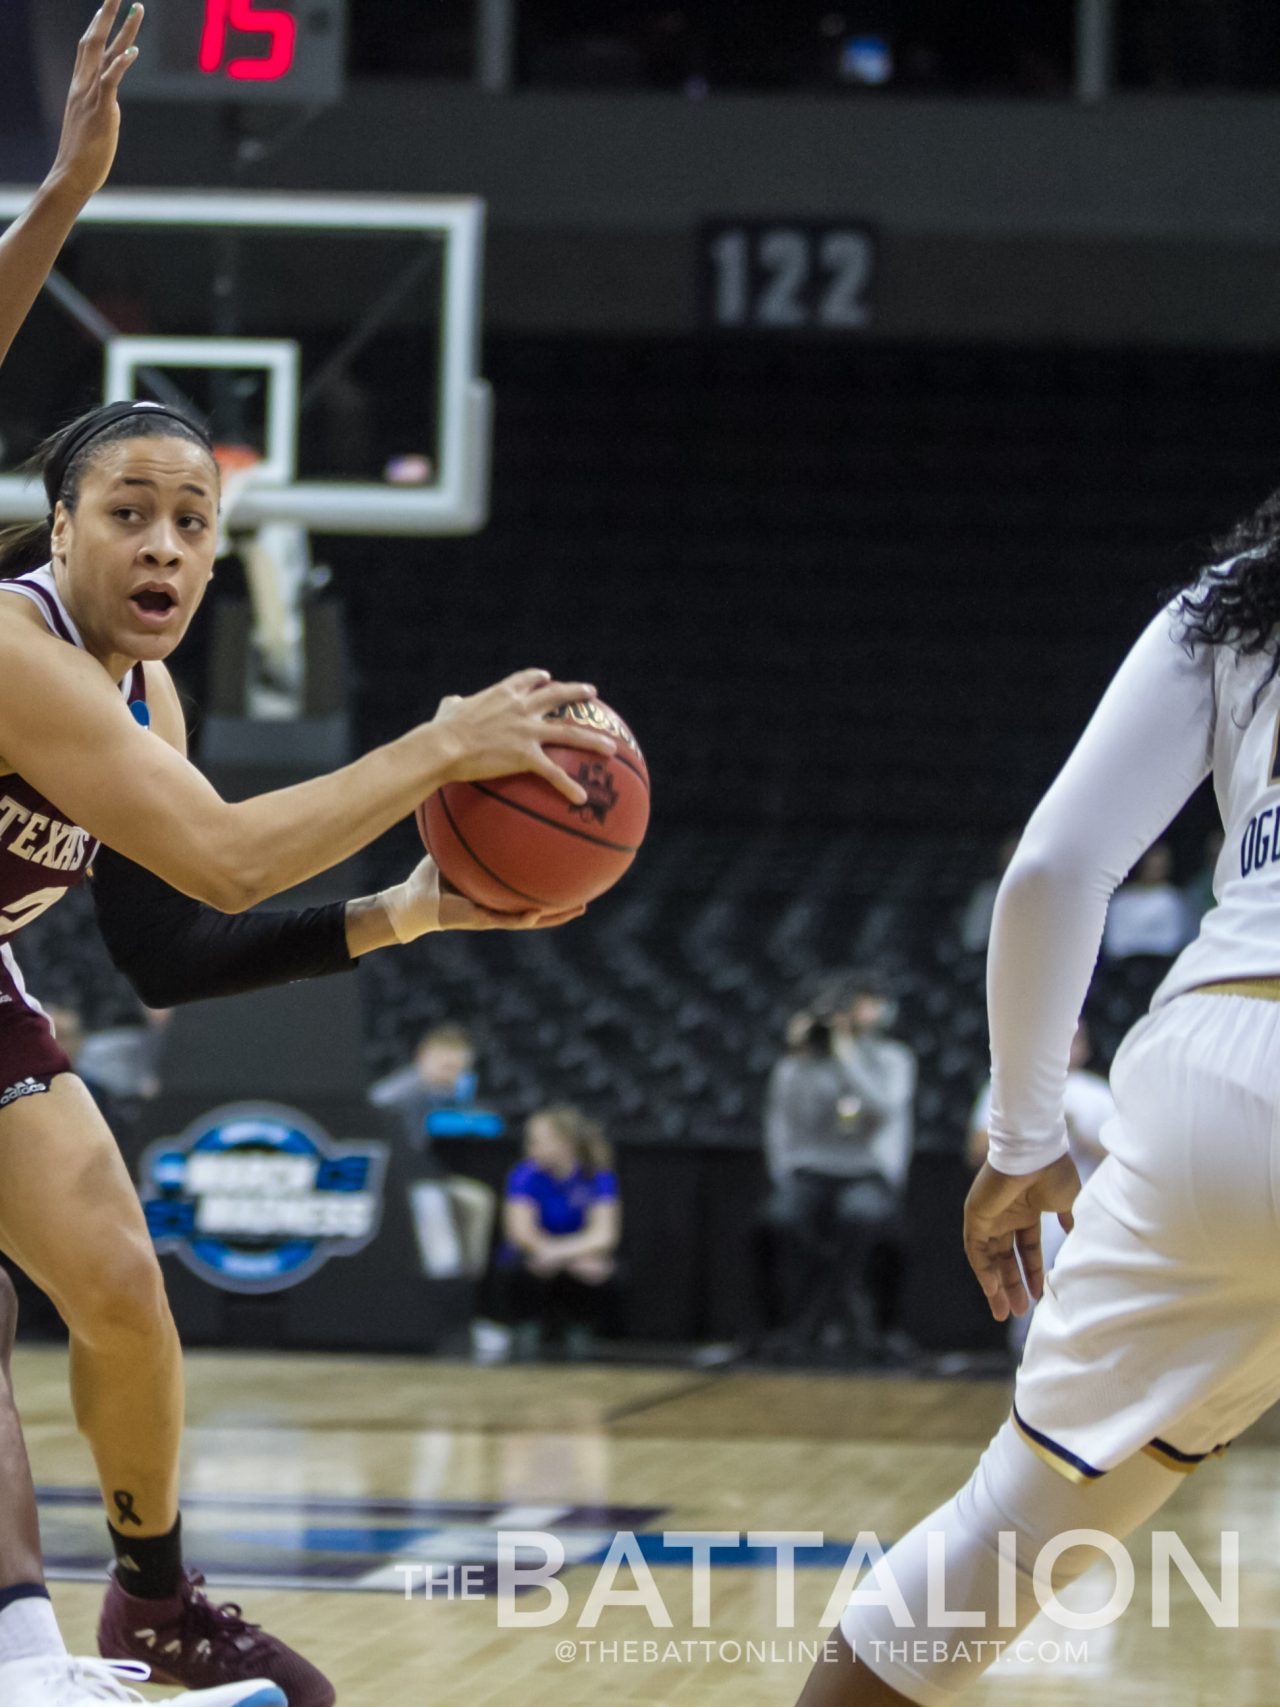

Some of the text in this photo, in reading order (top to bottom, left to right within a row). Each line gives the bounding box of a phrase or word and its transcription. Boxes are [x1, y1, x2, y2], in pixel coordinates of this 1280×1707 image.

[199, 0, 296, 81] 15
[711, 228, 871, 328] 122
[0, 1082, 46, 1105] adidas
